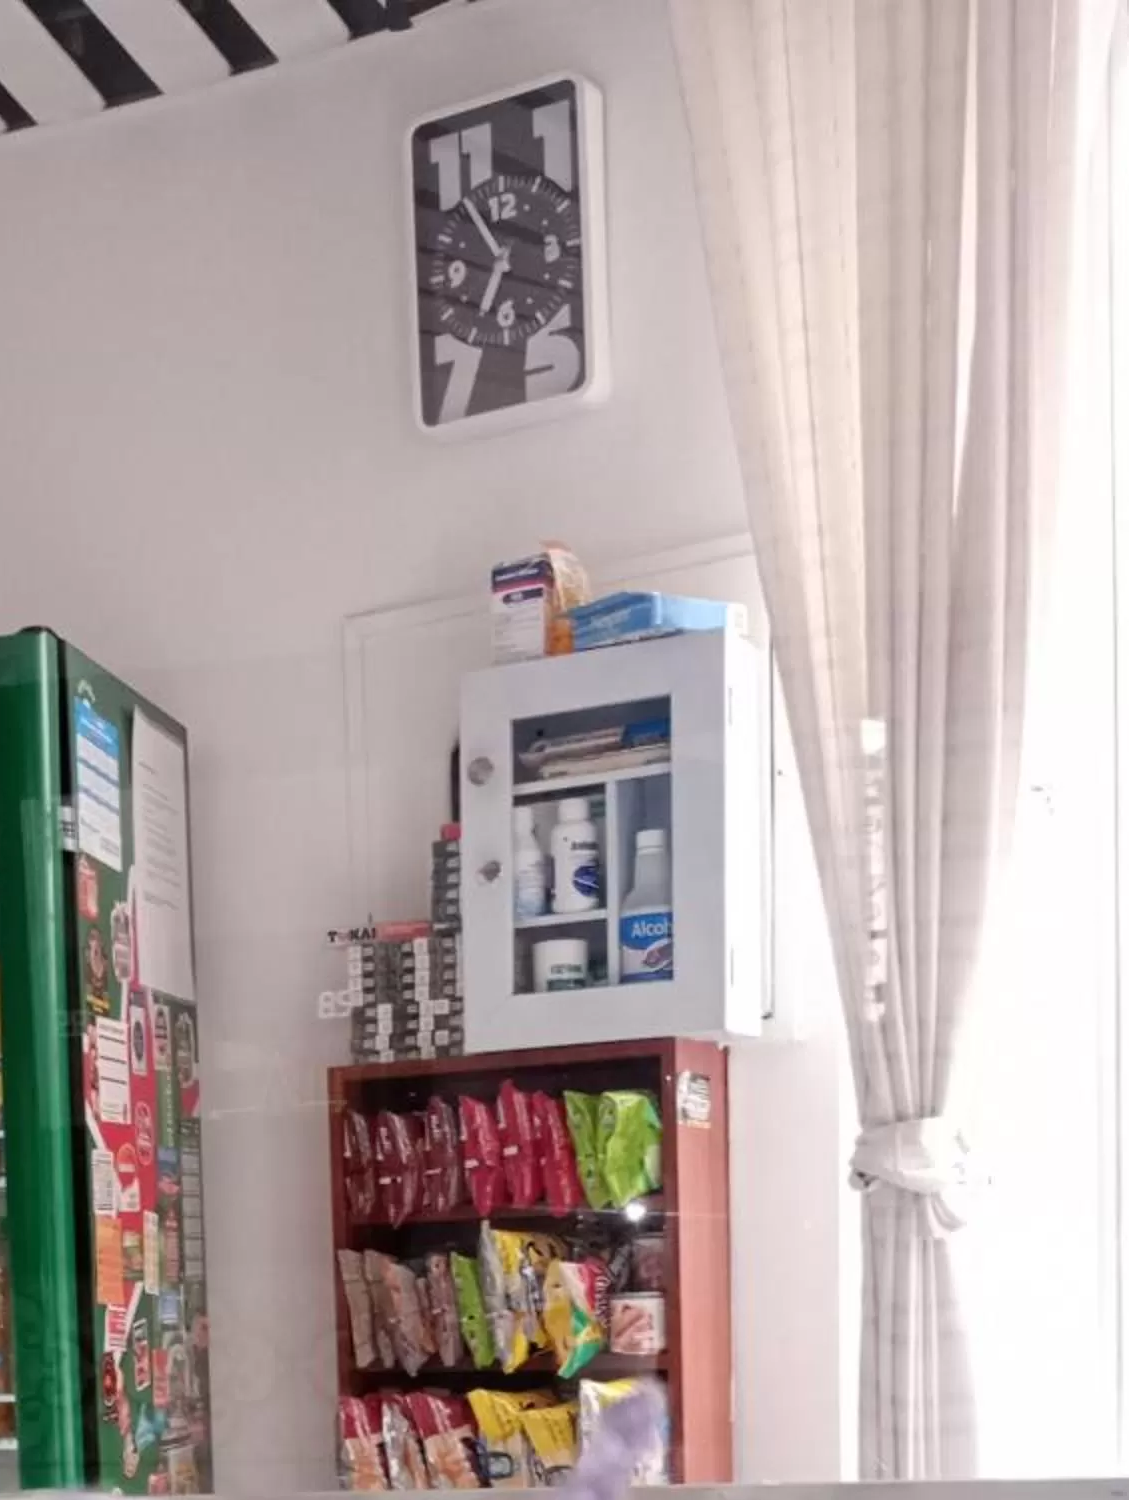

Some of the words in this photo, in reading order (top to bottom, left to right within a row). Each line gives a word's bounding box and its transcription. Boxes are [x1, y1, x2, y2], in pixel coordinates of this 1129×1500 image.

[531, 99, 571, 193] 1
[429, 122, 493, 212] 11
[488, 193, 517, 221] 12
[543, 234, 560, 262] 3
[447, 260, 466, 288] 9
[496, 300, 515, 327] 6
[434, 333, 483, 423] 7
